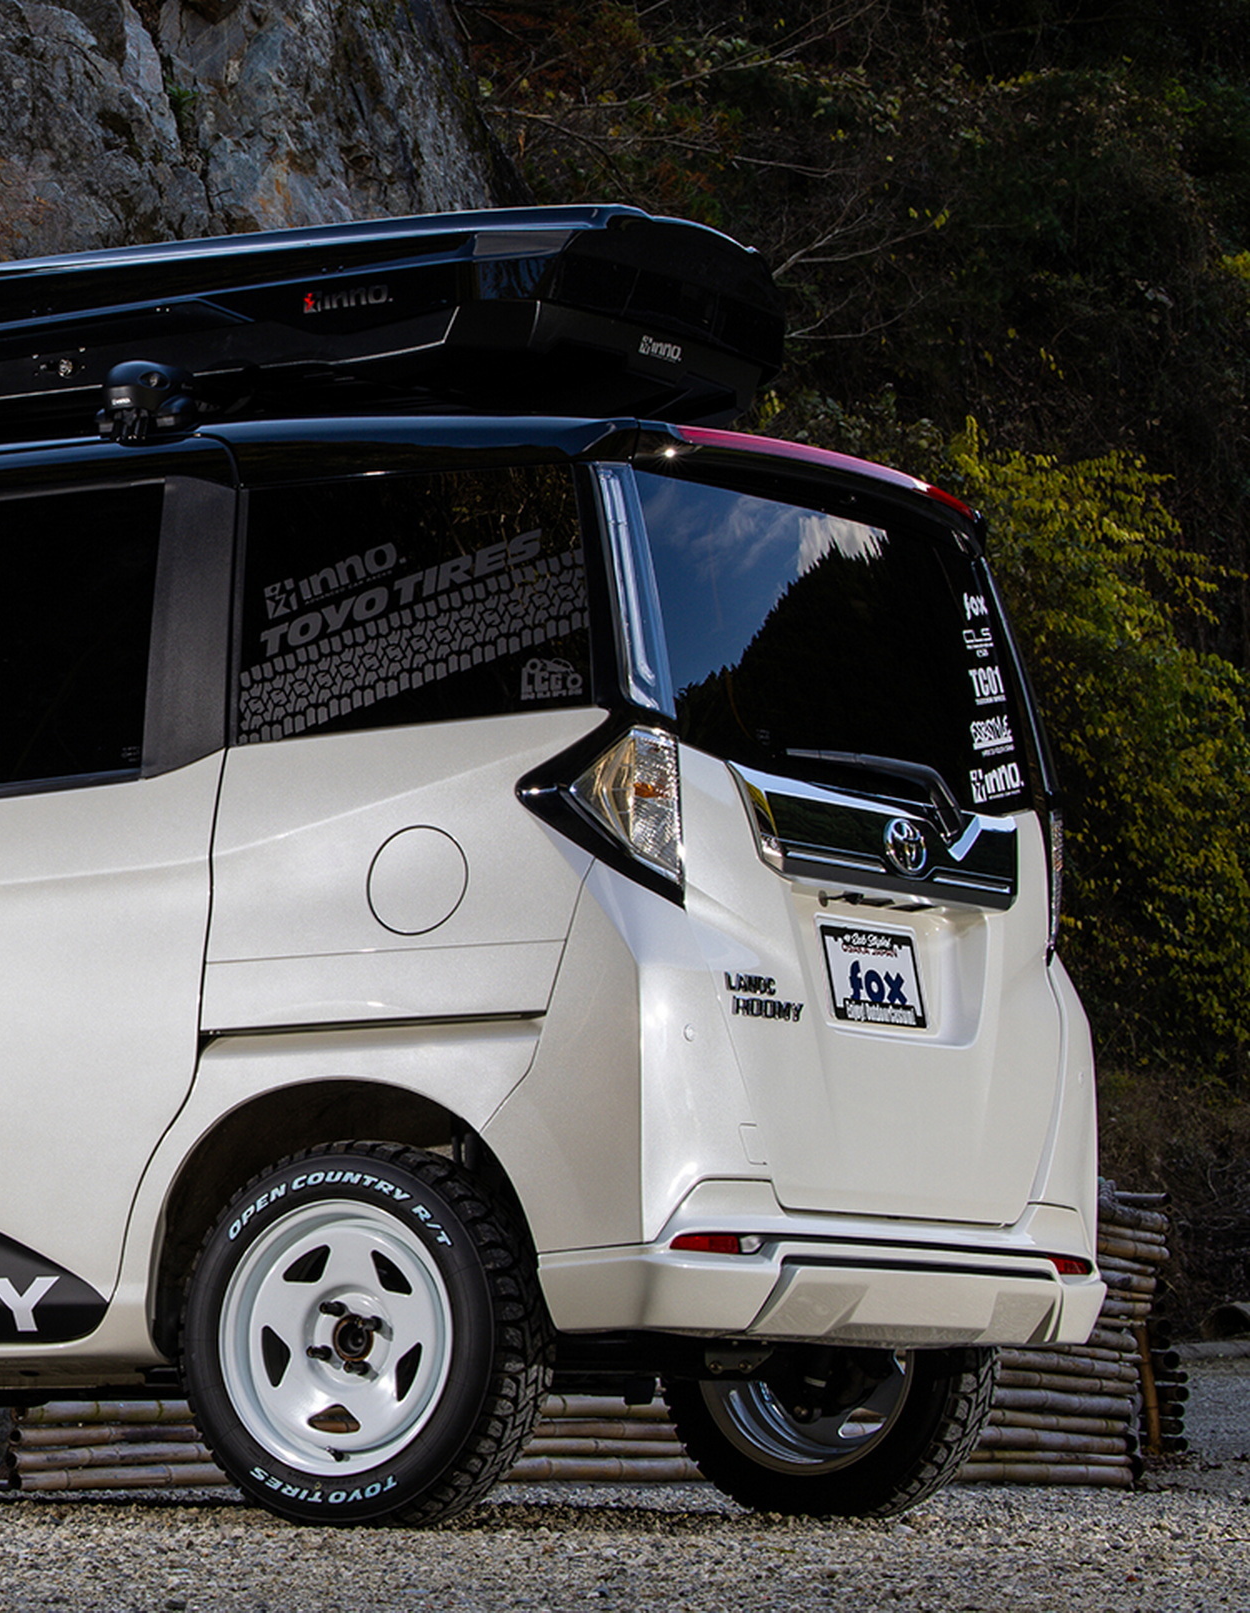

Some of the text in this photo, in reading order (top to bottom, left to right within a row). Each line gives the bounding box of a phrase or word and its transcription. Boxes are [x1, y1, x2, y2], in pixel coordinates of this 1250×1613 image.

[259, 529, 542, 657] TOYO TIRES
[968, 665, 1005, 698] TC01
[724, 971, 777, 996] LANDC
[848, 959, 908, 1006] fox
[732, 995, 804, 1023] ROOMY
[228, 1170, 453, 1248] OPEN COUNTRY R/T
[250, 1466, 399, 1504] TOYO TIRES
